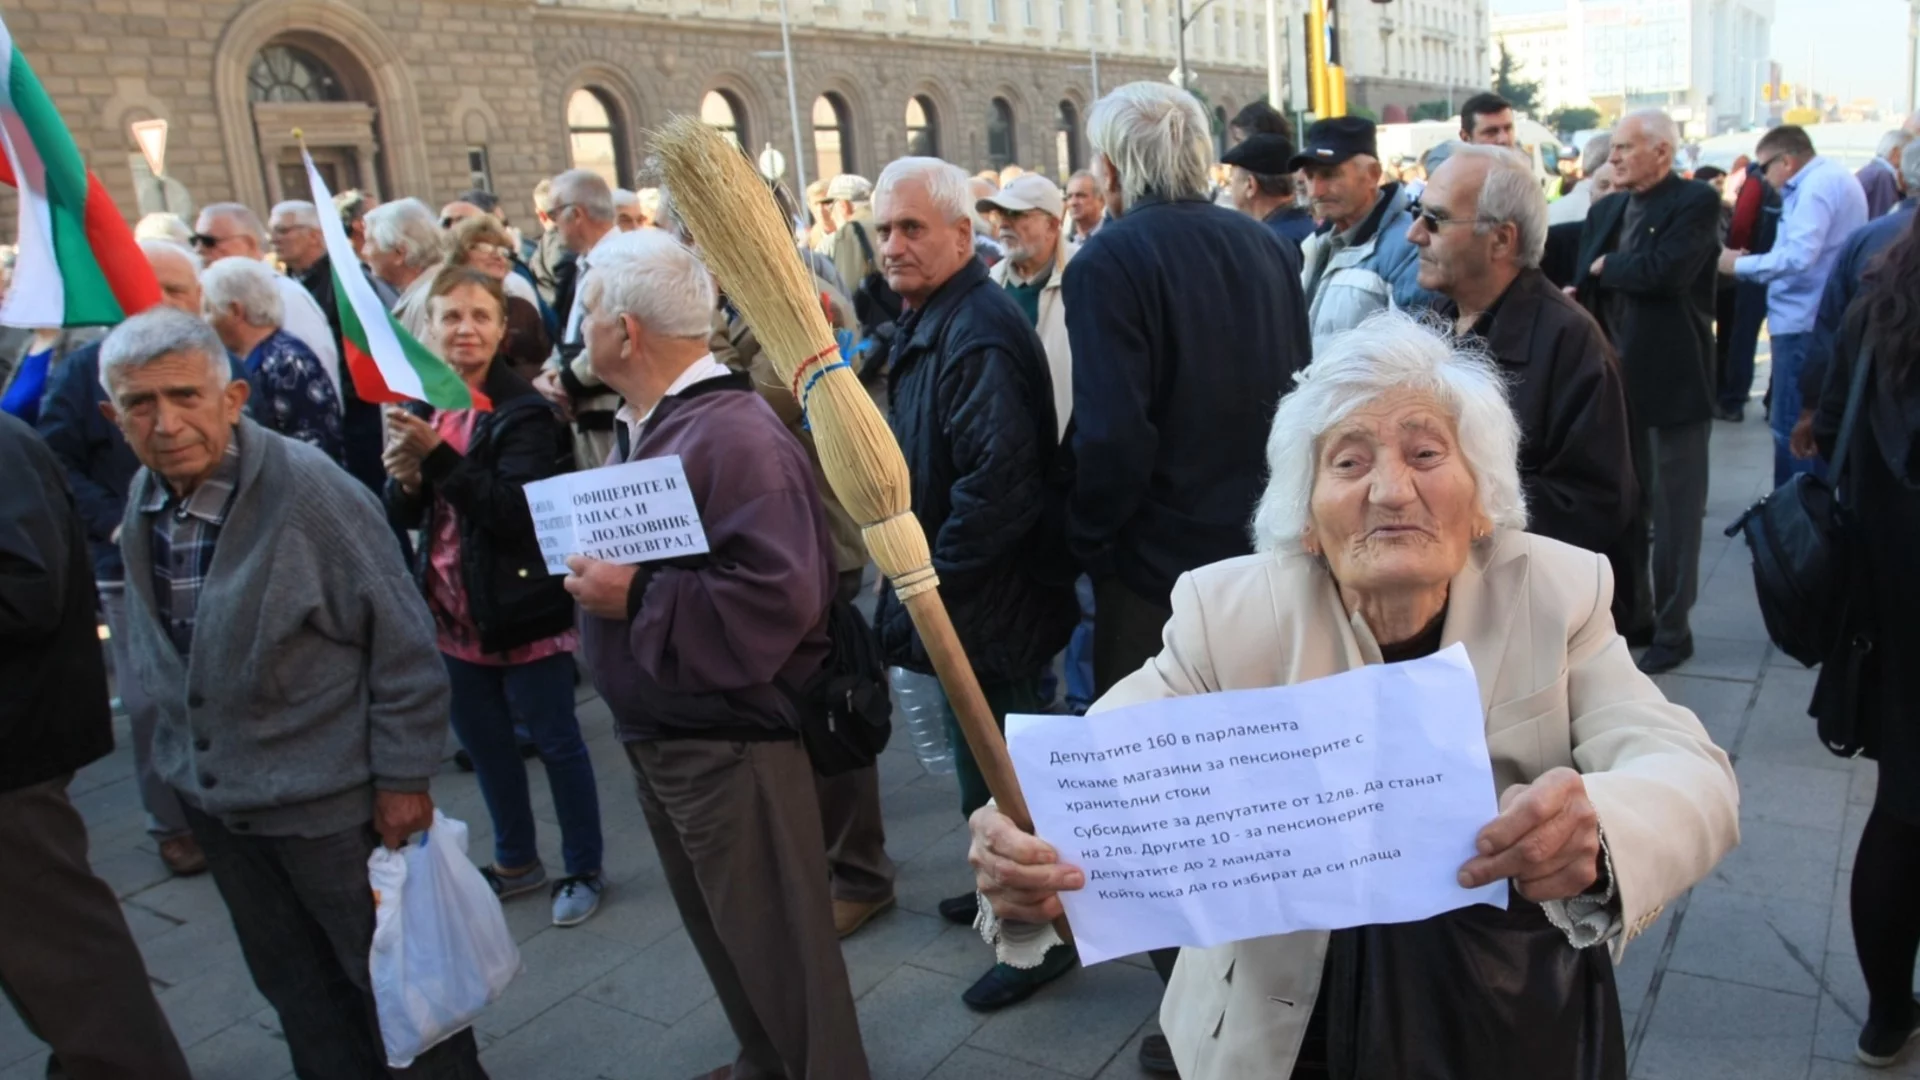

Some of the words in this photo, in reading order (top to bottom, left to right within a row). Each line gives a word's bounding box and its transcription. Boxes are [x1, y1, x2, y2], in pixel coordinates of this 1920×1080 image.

[573, 480, 662, 506] ОФИЦЕРИТЕ
[664, 477, 677, 490] И
[576, 505, 633, 526] ЗАПАСА
[635, 502, 648, 515] И
[583, 533, 695, 561] БЛАГОЕВГРАД
[1050, 742, 1142, 765] Депутатите
[1147, 733, 1177, 749] 160
[1182, 734, 1191, 745] в
[1195, 720, 1299, 743] парламента
[1057, 777, 1118, 789] Искаме
[1123, 762, 1202, 785] магазини
[1207, 759, 1224, 771] за
[1229, 738, 1351, 766] пенсионерите
[1355, 734, 1364, 743] с
[1066, 793, 1160, 813] хранителни
[1165, 786, 1211, 801] стоки
[1073, 819, 1168, 839] Субсидиите
[1173, 816, 1190, 827] за
[1195, 799, 1287, 827] депутатите
[1292, 796, 1310, 807] от
[1316, 787, 1359, 804] 12лв.
[1364, 780, 1384, 794] да
[1388, 773, 1443, 789] станат
[1081, 849, 1099, 859] на
[1105, 845, 1137, 858] 2лв.
[1141, 837, 1205, 856] Другите
[1211, 831, 1230, 845] 10
[1245, 827, 1262, 839] за
[1267, 801, 1385, 835] пенсионерите
[1090, 864, 1178, 881] Депутатите
[1183, 860, 1203, 872] до
[1208, 858, 1217, 868] 2
[1222, 848, 1291, 867] мандата
[1098, 888, 1145, 900] Който
[1149, 888, 1184, 899] иска
[1188, 882, 1207, 895] да
[1212, 880, 1228, 889] го
[1232, 869, 1298, 888] избират
[1302, 866, 1322, 879] да
[1326, 862, 1345, 873] си
[1350, 849, 1401, 868] плаща
